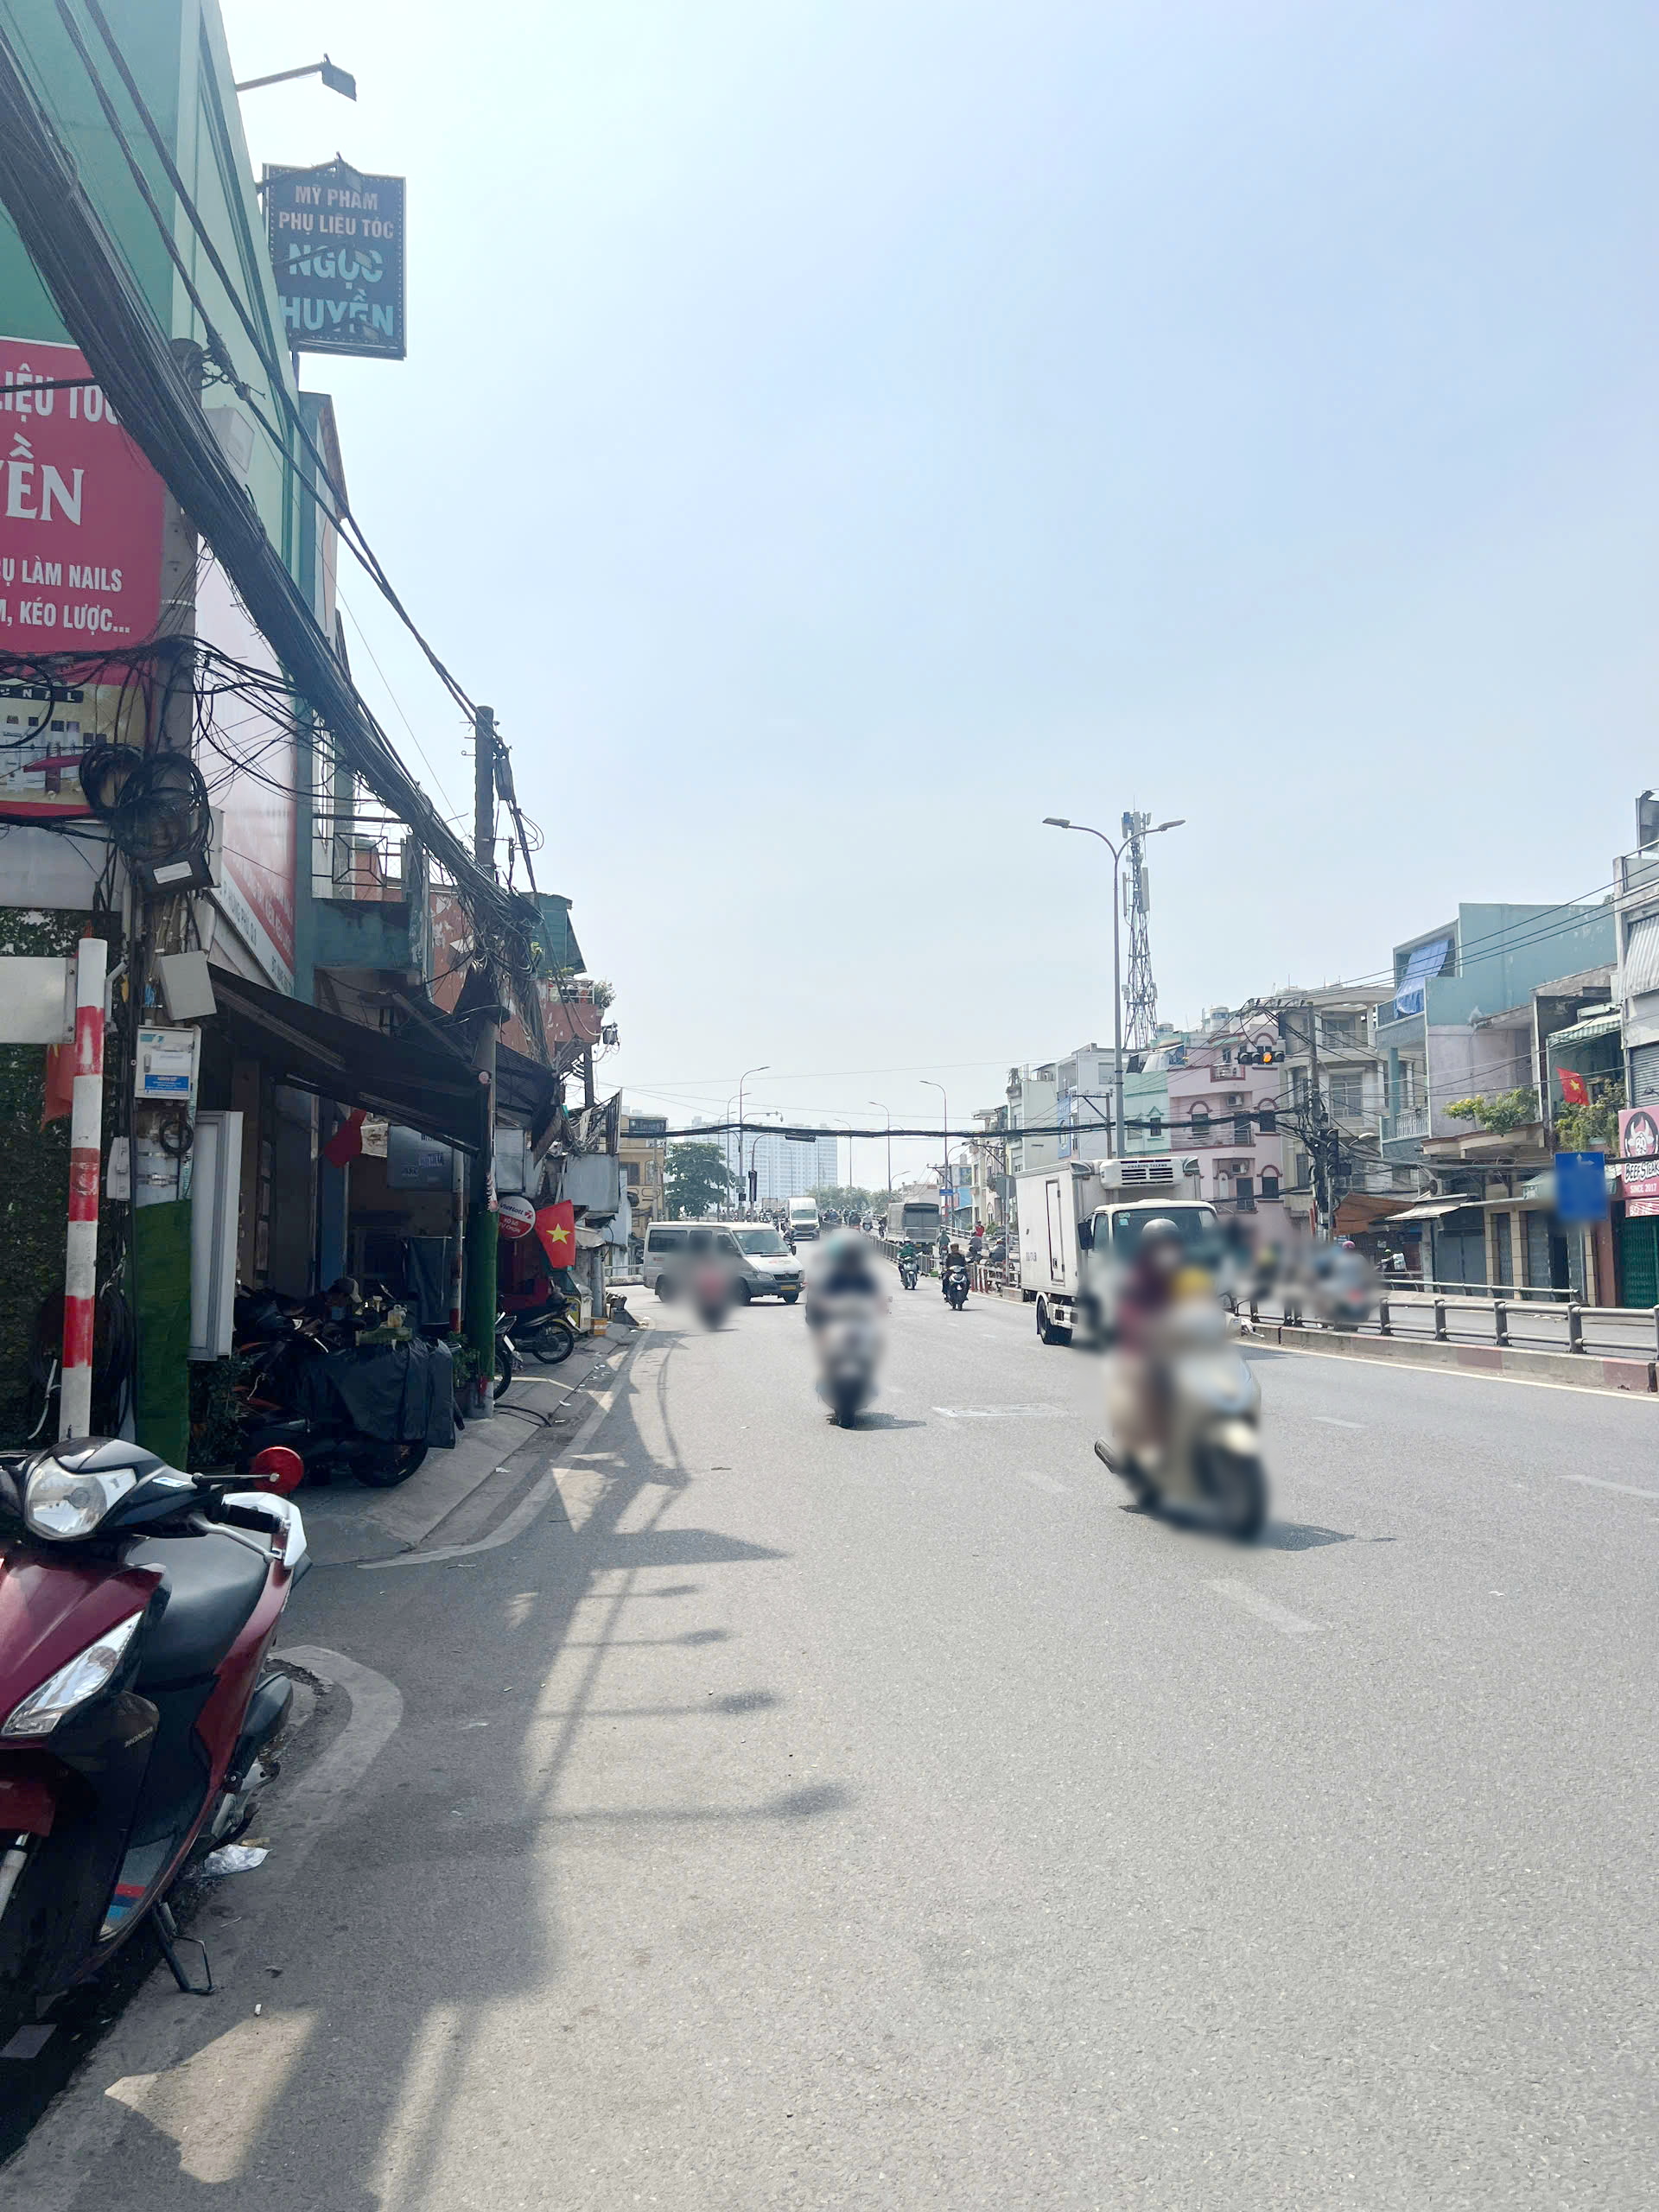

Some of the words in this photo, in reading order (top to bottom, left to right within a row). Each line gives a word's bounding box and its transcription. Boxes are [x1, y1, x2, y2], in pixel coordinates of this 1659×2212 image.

[279, 212, 314, 235] PHỤ
[361, 216, 394, 238] TÓC
[289, 243, 383, 289] NGỌC
[0, 363, 54, 422] IỆU
[0, 432, 85, 526] ỀN
[0, 558, 16, 587] Ụ
[22, 556, 62, 587] LÀM
[69, 564, 123, 592] NAILS
[20, 597, 57, 626] KÉO
[63, 604, 130, 636] LƯỢC...
